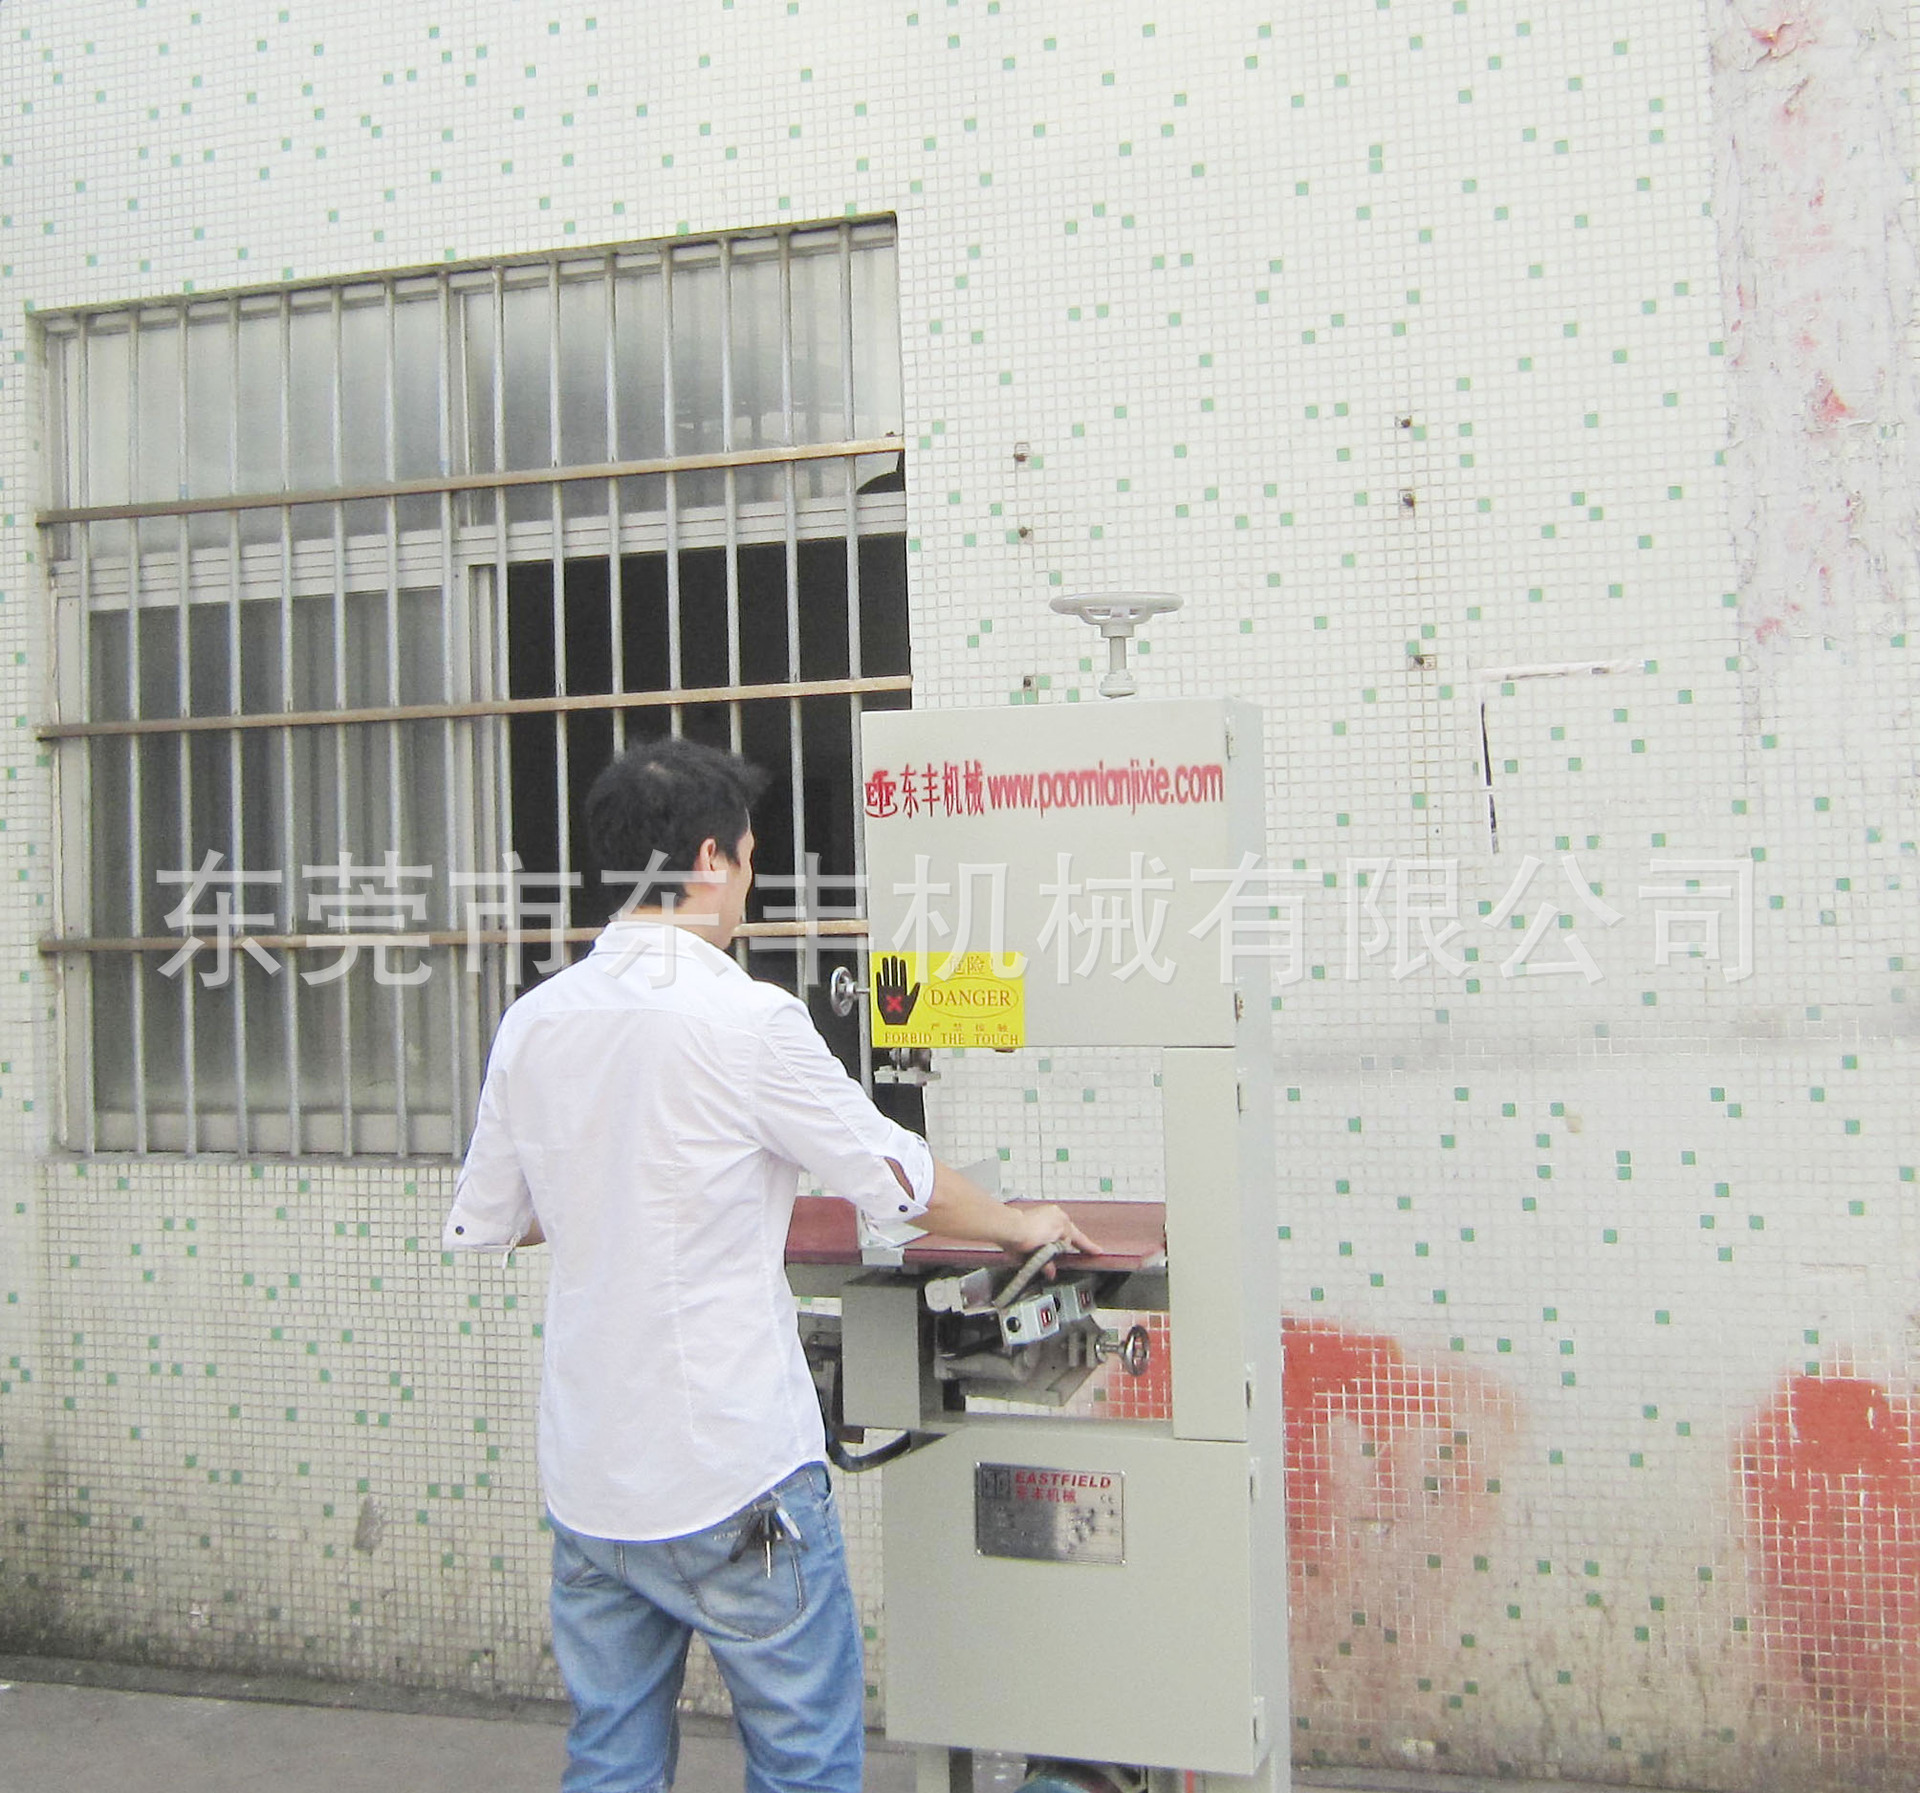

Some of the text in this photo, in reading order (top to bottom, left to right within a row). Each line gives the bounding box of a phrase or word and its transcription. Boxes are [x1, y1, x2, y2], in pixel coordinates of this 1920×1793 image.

[900, 760, 984, 819] 东丰机械
[930, 989, 1011, 1006] DANGER
[884, 1032, 1018, 1045] FORBID THE TOUCH
[1015, 1470, 1111, 1489] EASTFIELD
